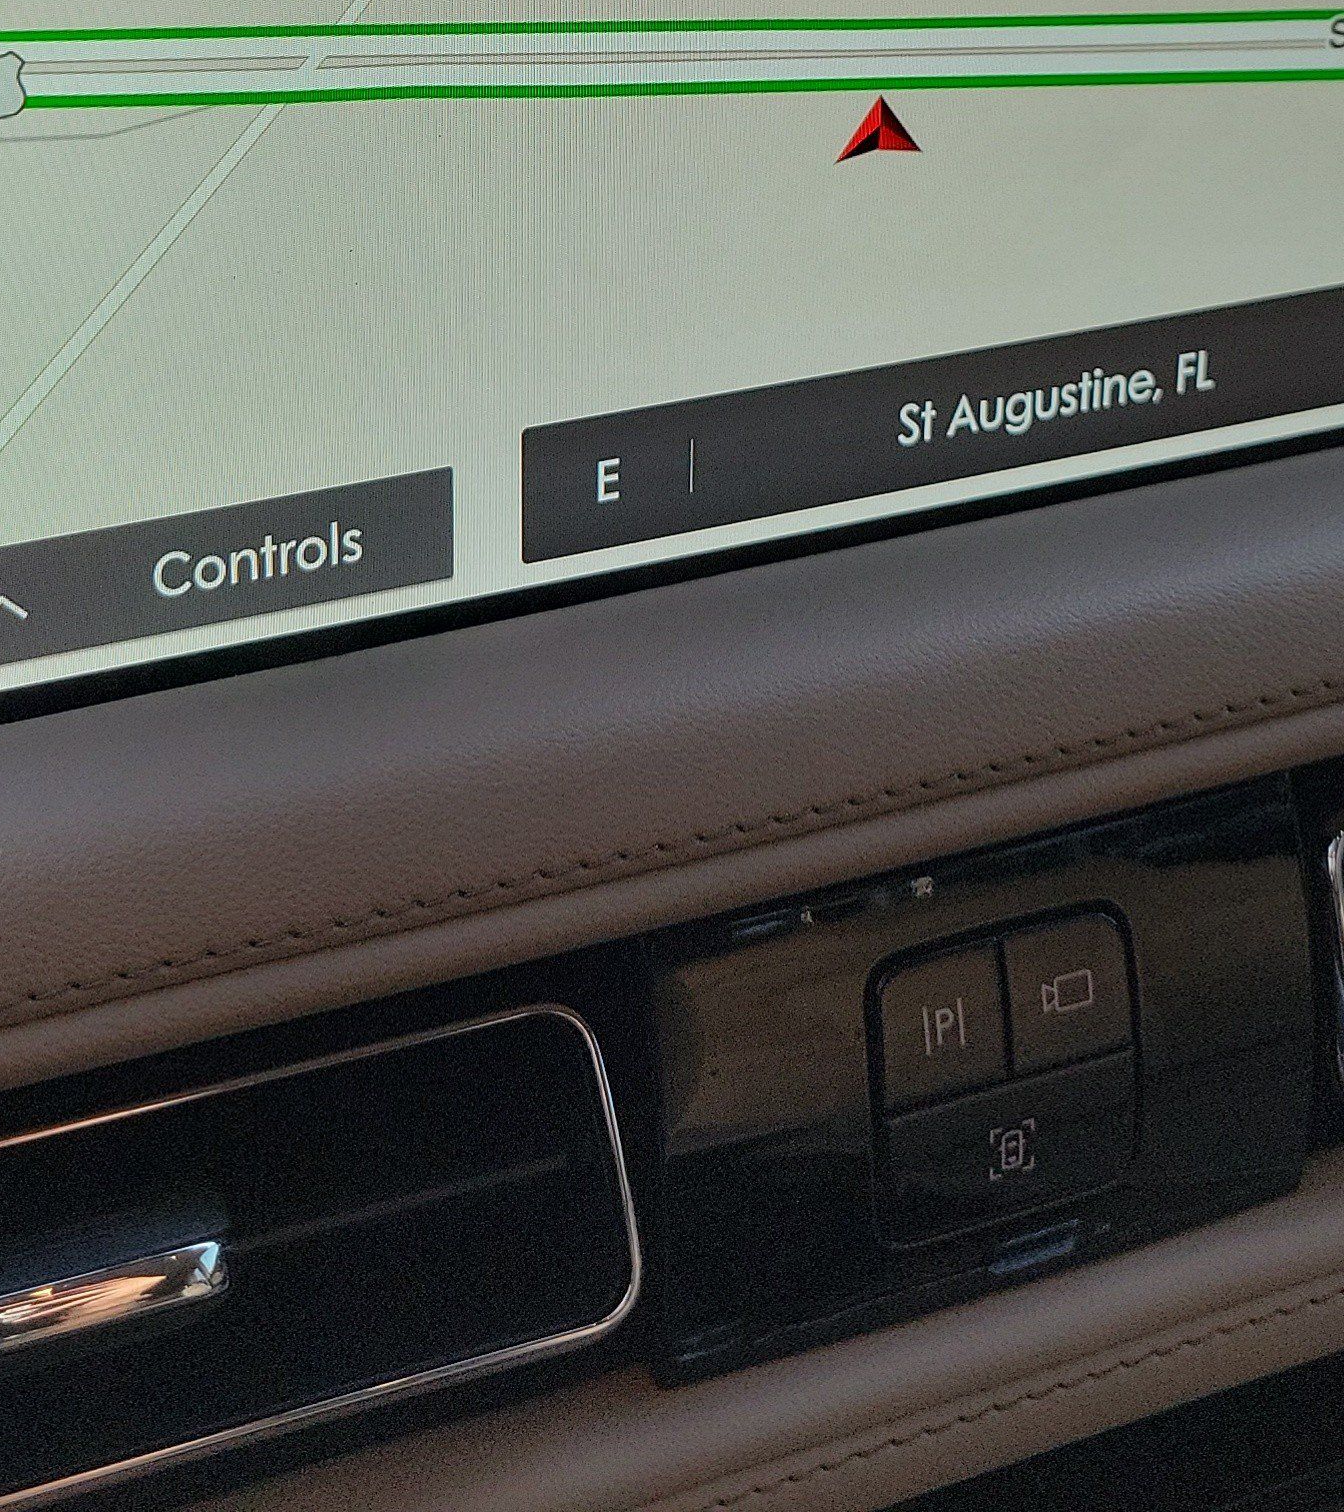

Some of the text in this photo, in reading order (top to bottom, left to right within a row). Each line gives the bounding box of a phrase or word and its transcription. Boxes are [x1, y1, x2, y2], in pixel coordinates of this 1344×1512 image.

[897, 350, 1217, 448] St Augustine, FL
[596, 458, 621, 502] E
[153, 520, 364, 597] Controls
